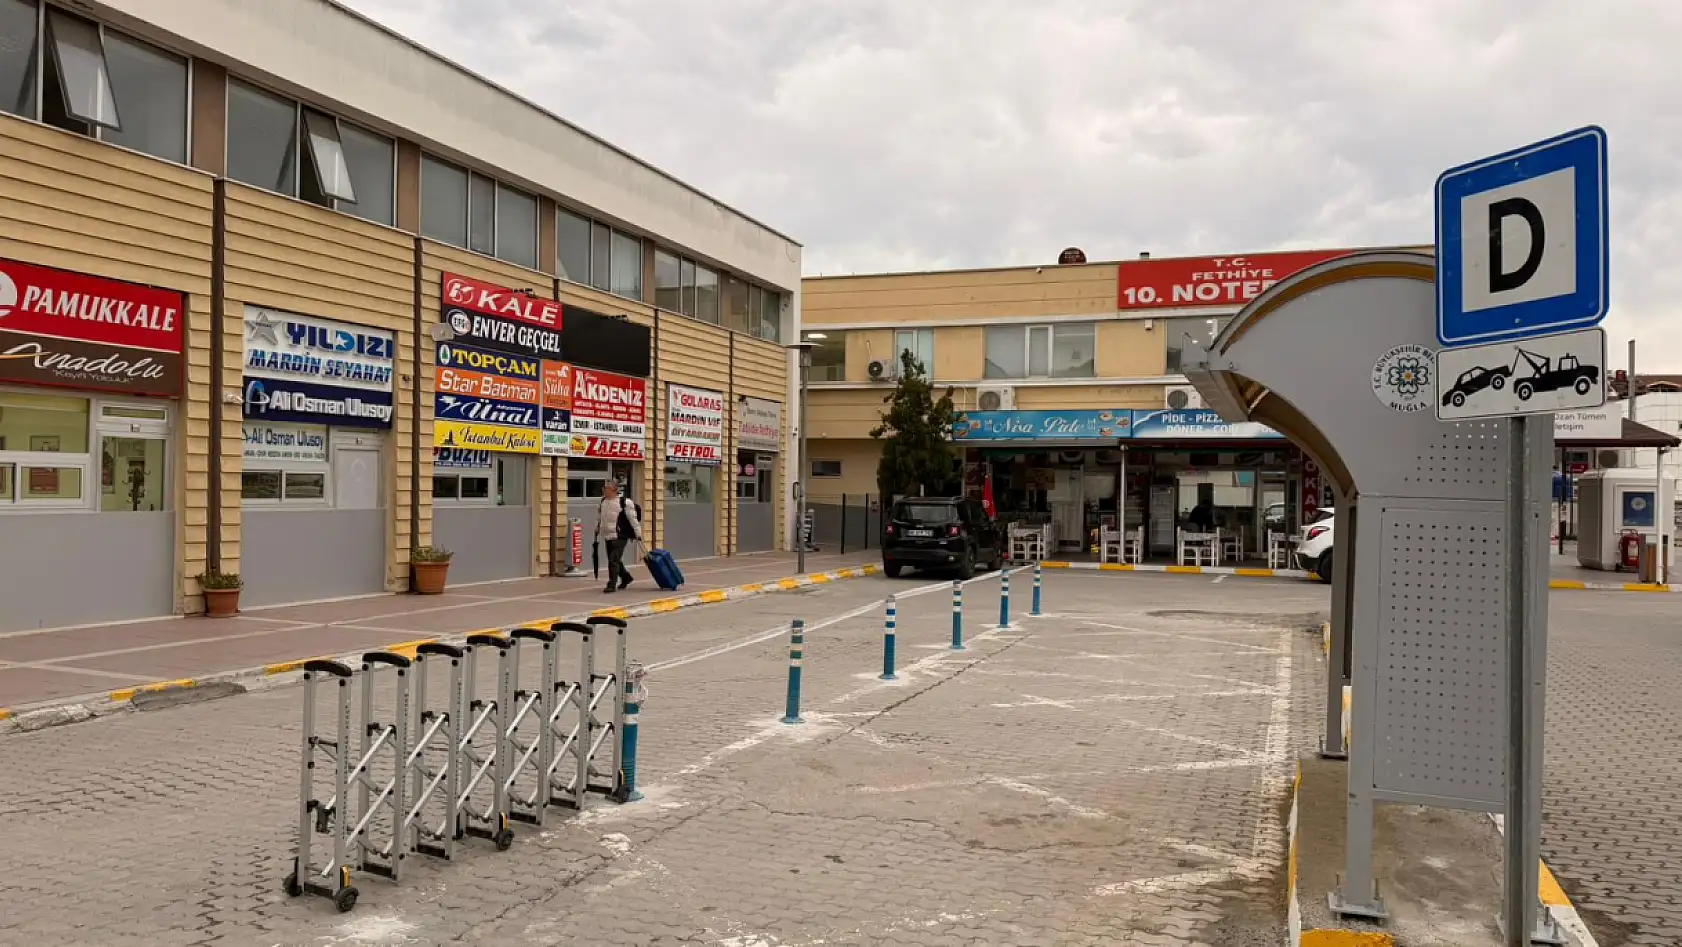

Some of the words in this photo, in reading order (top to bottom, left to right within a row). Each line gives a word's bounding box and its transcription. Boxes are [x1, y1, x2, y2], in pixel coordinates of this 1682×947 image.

[1488, 197, 1545, 294] D
[1192, 268, 1274, 281] FETHİYE
[1213, 257, 1252, 268] T.C.
[21, 285, 177, 333] PAMUKKALE
[477, 289, 558, 325] KALE
[1123, 286, 1164, 305] 10.
[284, 322, 394, 359] YILDIZI
[471, 315, 516, 344] ENVER
[517, 326, 561, 353] GEÇGEL
[2, 342, 165, 379] Anadolu
[247, 349, 322, 375] MARDİN
[323, 359, 392, 384] SEYAHAT
[452, 348, 538, 378] TOPÇAM
[439, 369, 479, 394] Star
[480, 376, 537, 402] Batman
[573, 369, 643, 407] AKDENİZ
[269, 389, 291, 412] Ali
[291, 392, 346, 416] Osman
[345, 397, 393, 423] Ulusoy
[460, 398, 534, 425] Ünal
[1162, 412, 1186, 423] PİDE
[1195, 412, 1223, 423] PİZZ
[266, 428, 295, 446] Osman
[296, 429, 324, 450] Ulusoy
[584, 435, 640, 457] ZAFER
[674, 444, 717, 459] PETROL
